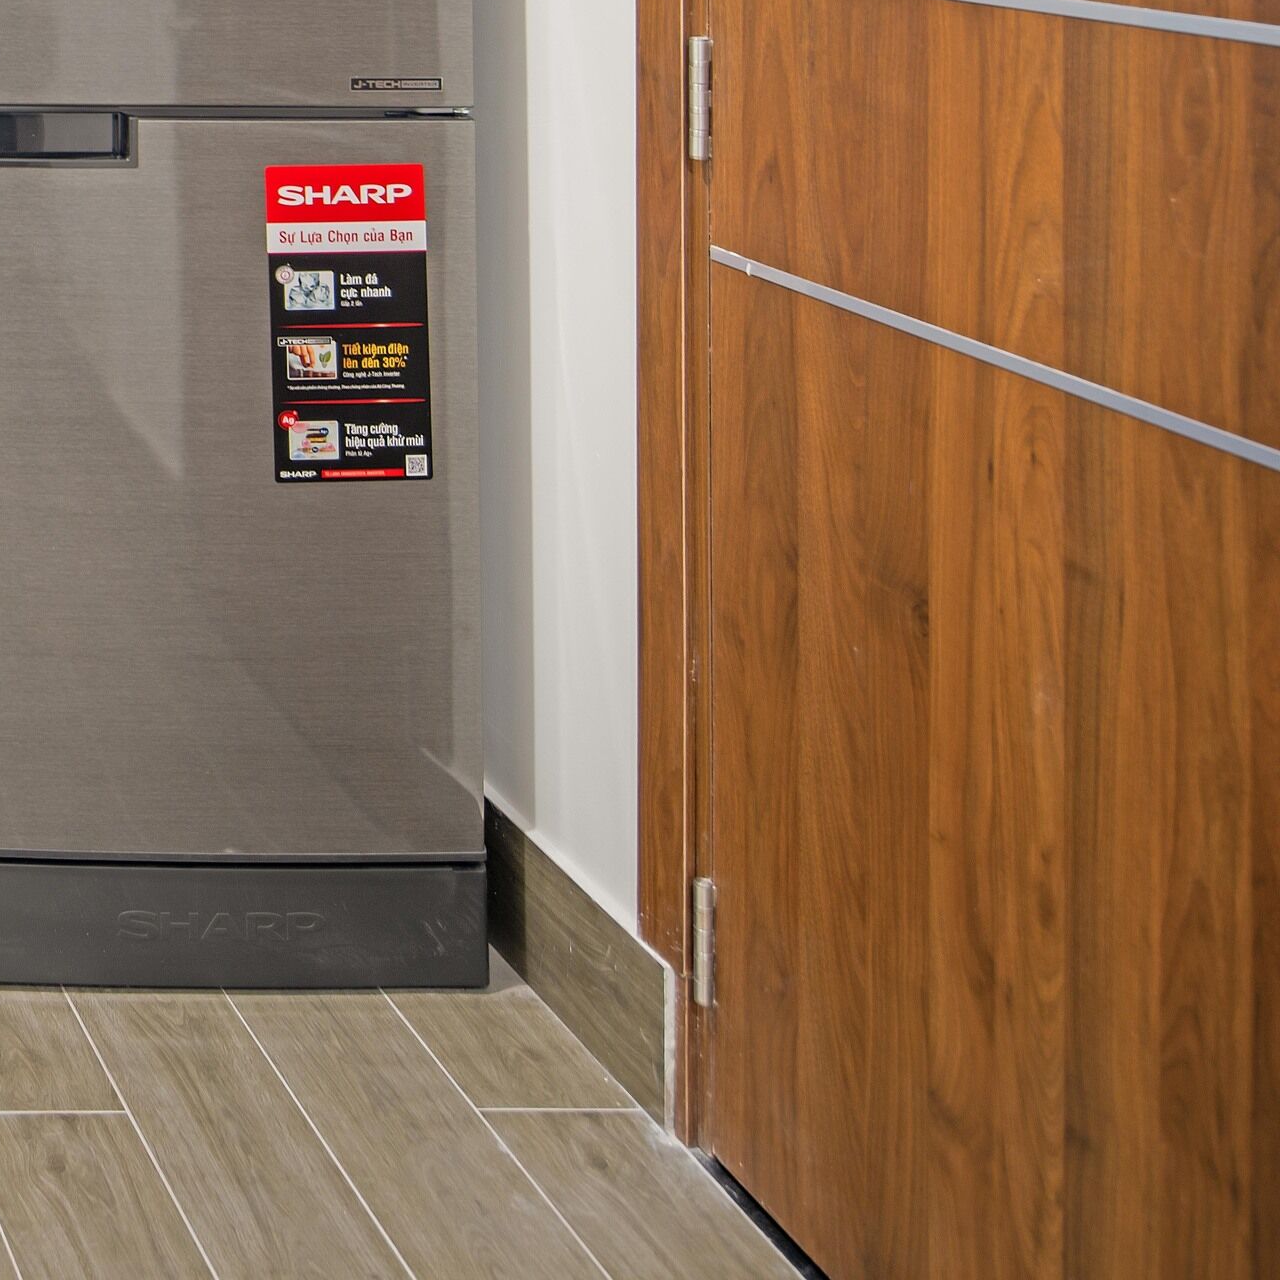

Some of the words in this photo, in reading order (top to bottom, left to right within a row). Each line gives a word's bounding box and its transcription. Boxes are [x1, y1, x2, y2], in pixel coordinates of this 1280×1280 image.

[353, 80, 401, 89] J-TECH
[277, 183, 412, 206] SHARP
[279, 231, 296, 246] Sự
[300, 231, 322, 246] Lựa
[328, 230, 358, 245] Chọn
[363, 228, 385, 242] của
[390, 229, 413, 244] Bạn
[340, 273, 362, 285] Làm
[365, 273, 378, 285] đá
[340, 287, 358, 300] cực
[360, 285, 392, 298] nhanh
[362, 343, 387, 359] kiệm
[343, 357, 359, 369] lên
[344, 423, 369, 437] Tăng
[370, 422, 399, 436] cường
[345, 435, 367, 449] hiệu
[367, 435, 386, 449] quả
[386, 434, 406, 447] khử
[406, 434, 425, 446] mùi
[280, 470, 317, 478] SHARP
[117, 910, 326, 941] SHARP
